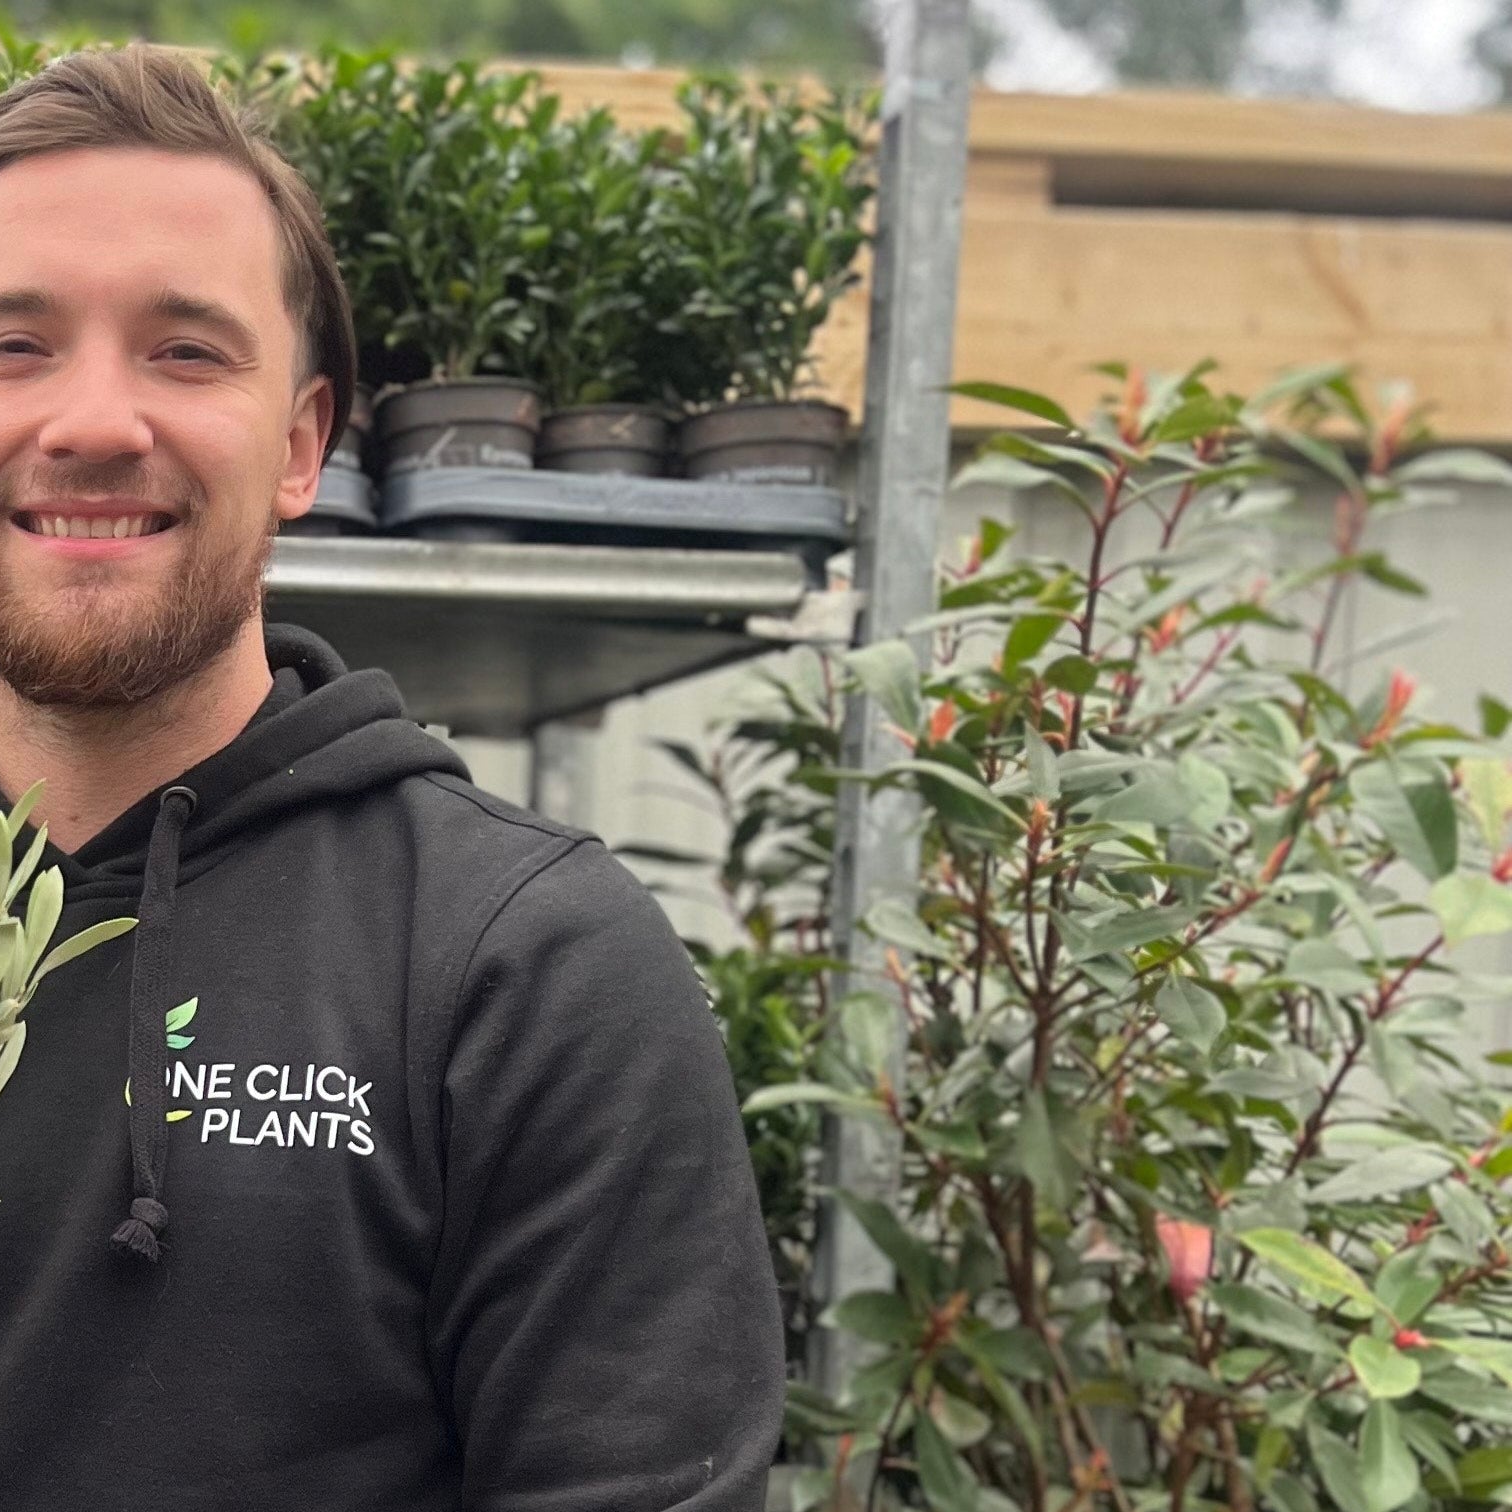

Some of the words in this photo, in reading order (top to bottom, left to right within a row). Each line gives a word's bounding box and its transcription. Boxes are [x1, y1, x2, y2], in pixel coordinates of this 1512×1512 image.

[165, 1060, 236, 1100] NE
[246, 1063, 373, 1117] CLICK
[201, 1108, 376, 1156] PLANTS
